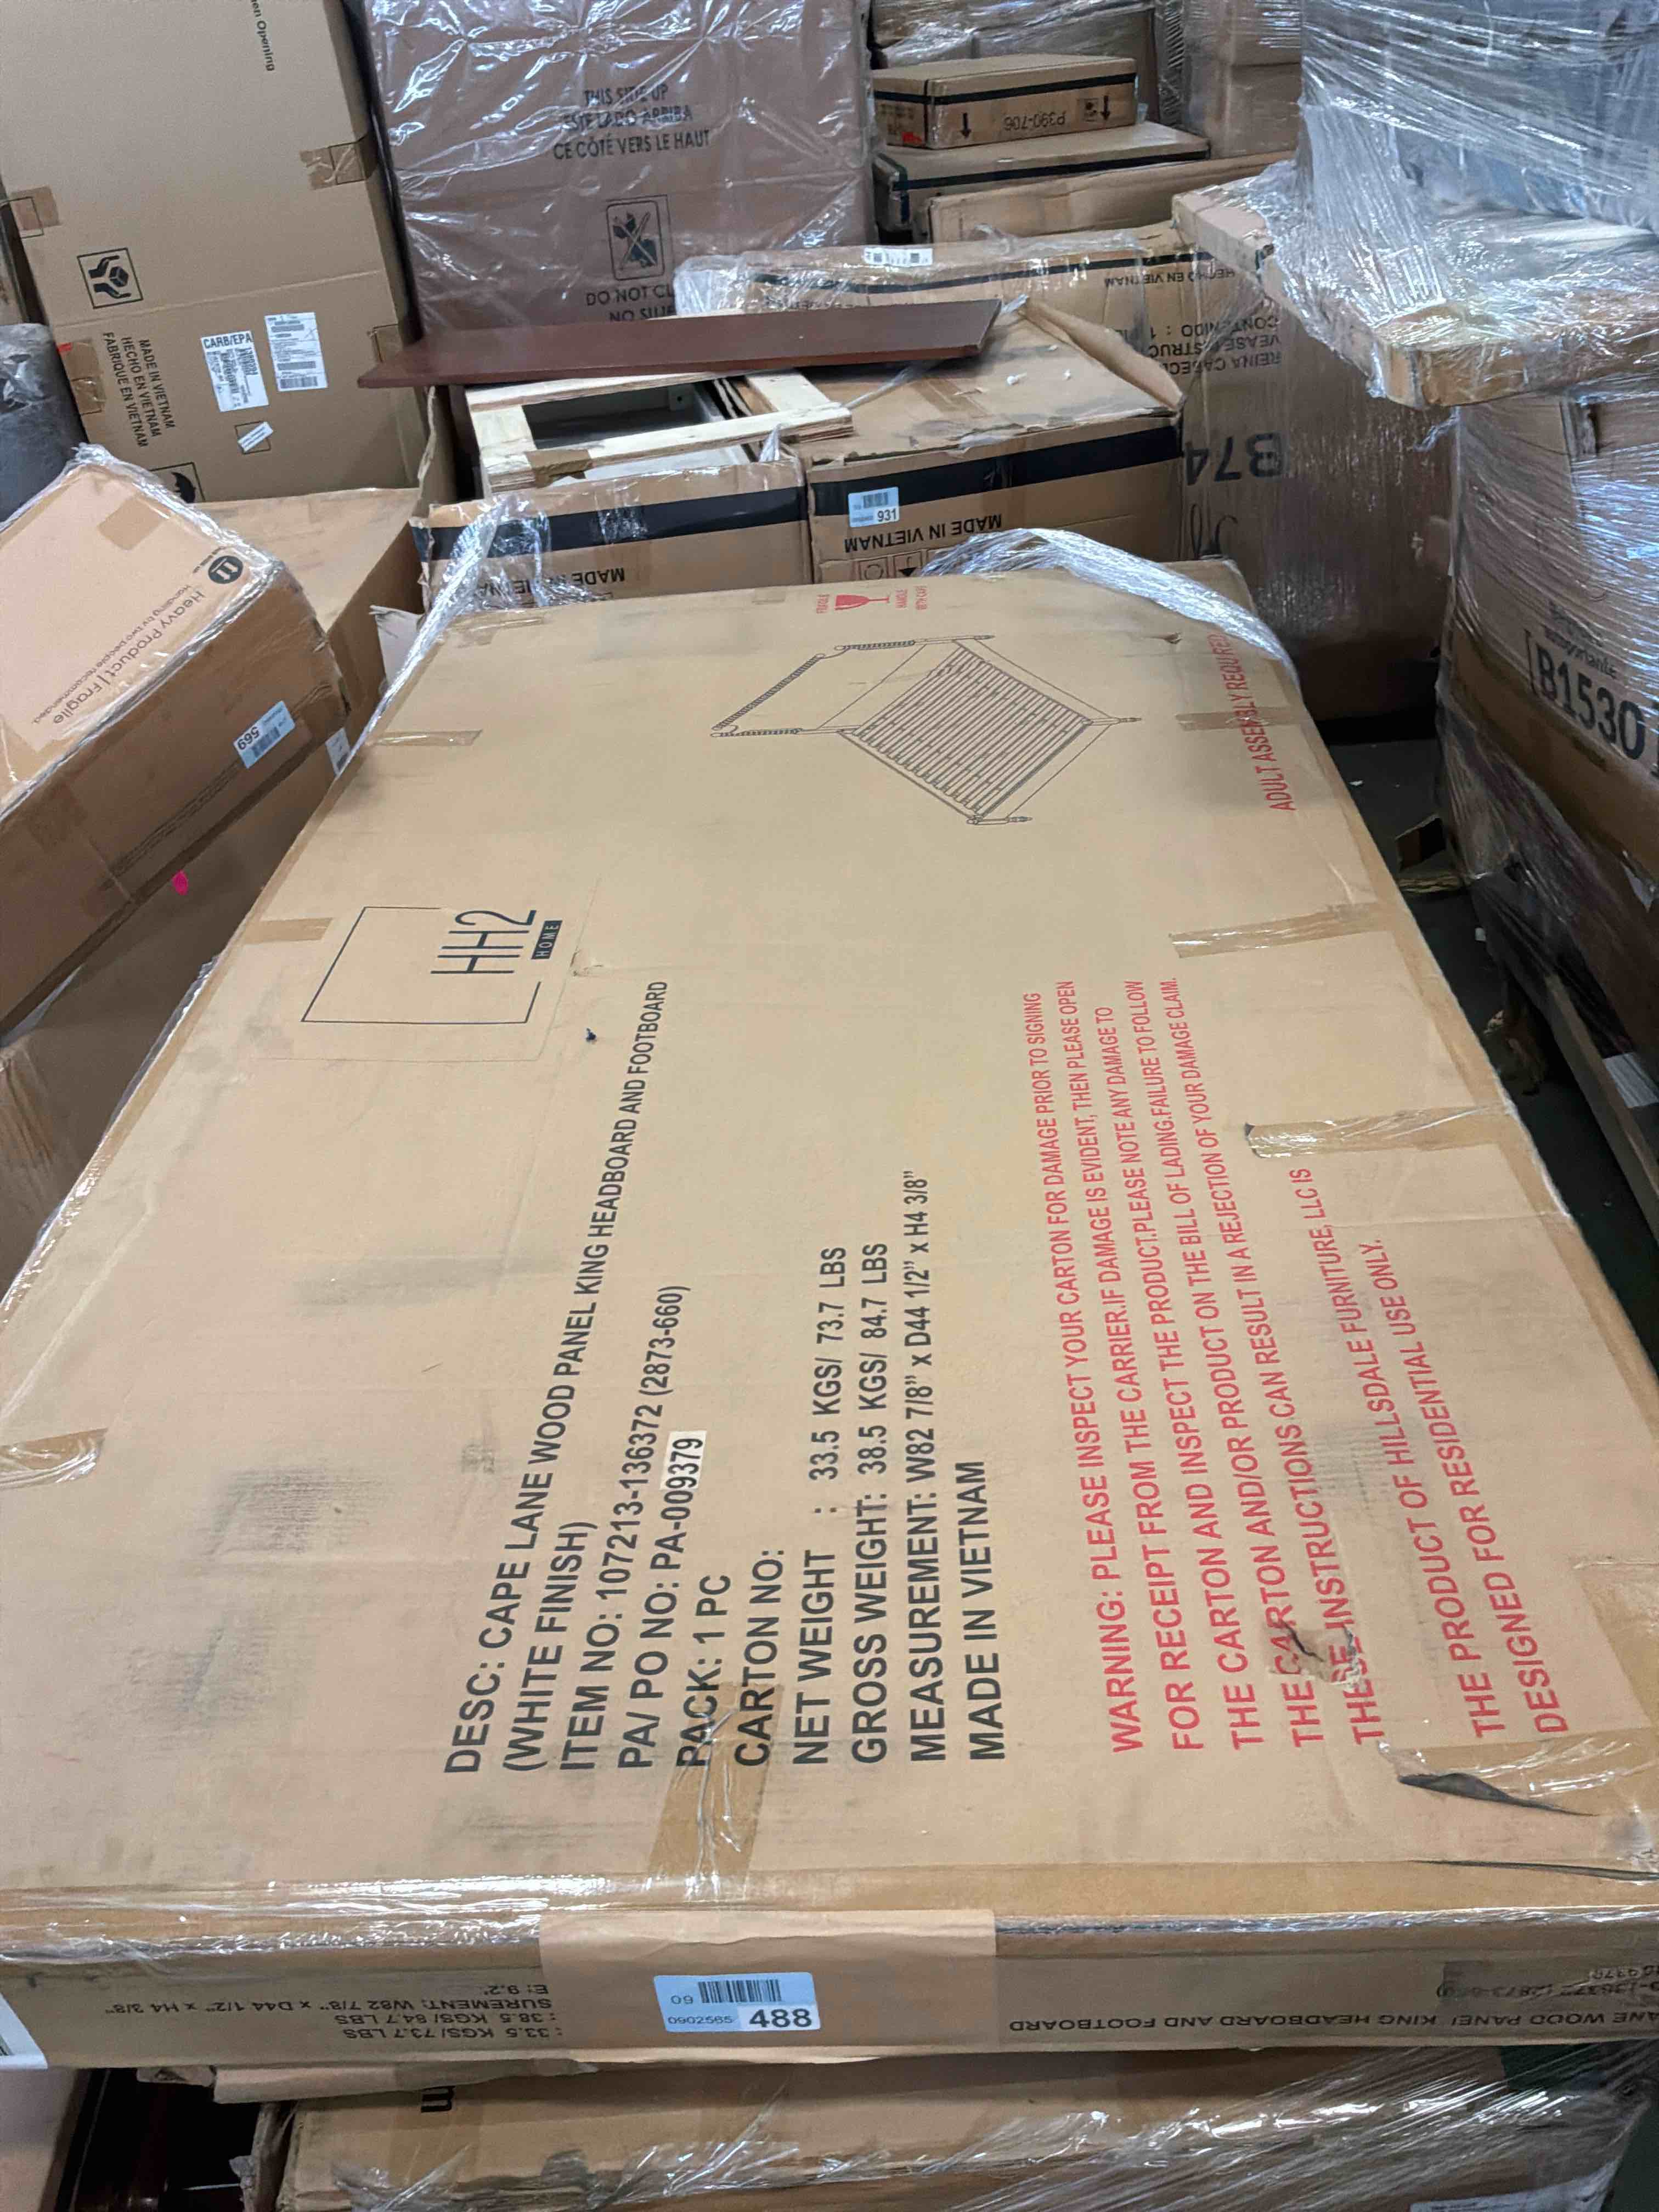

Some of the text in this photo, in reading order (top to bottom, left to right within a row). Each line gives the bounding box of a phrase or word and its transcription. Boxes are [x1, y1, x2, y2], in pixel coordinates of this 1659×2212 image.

[257, 21, 275, 71] Opening
[554, 142, 573, 159] CE
[617, 136, 652, 155] VERS
[656, 134, 670, 150] LE
[674, 129, 709, 149] HAUT
[586, 286, 652, 306] DO NOT
[1167, 272, 1184, 283] EN
[103, 332, 148, 448] FABRIQUE EN VIETNAM
[121, 336, 161, 437] HECHO EN VIETNAM
[139, 339, 175, 428] MADE IN VIETNAM
[1184, 433, 1282, 486] B74
[845, 514, 1001, 553] MADE IN VIETNAM
[878, 509, 896, 522] 931
[572, 568, 625, 585] MADE
[161, 590, 205, 628] Heavy
[106, 629, 161, 676] Product
[53, 683, 103, 724] Fragile
[1208, 634, 1297, 810] ADULT ASSEMBLY REQUIRED
[1537, 645, 1645, 759] B1530
[238, 726, 259, 750] 569
[431, 909, 537, 974] HH2
[536, 922, 559, 958] HOME
[1056, 981, 1077, 1014] OPEN
[1060, 1018, 1086, 1068] PLEASE
[1069, 1073, 1092, 1111] THEN
[1074, 1115, 1104, 1182] EVIDENT,
[1085, 1187, 1108, 1202] IS
[904, 1211, 928, 1236] H4
[1088, 1207, 1121, 1283] DAMAGE
[819, 1248, 846, 1288] LBS
[816, 1302, 844, 1344] 73.7
[904, 1306, 931, 1346] D44
[444, 981, 667, 1773] DESC: CAPE LANE WOOD PANEL KING HEADBOARD AND FOOTBOARD
[812, 1358, 842, 1415] KGS/
[1023, 993, 1143, 1753] WARNING: PLEASE INSPECT YOUR CARTON FOR DAMAGE PRIOR TO SIGNING
[809, 1431, 839, 1480] 33.5
[905, 1428, 935, 1483] W82
[1120, 1409, 1151, 1453] THE
[1289, 1169, 1505, 1738] THE PRODUCT OF HILLSDALE FURNITURE, LLC IS
[851, 1244, 887, 1763] GROSS WEIGHT: 38.5 KGS/ 84.7 LBS
[1128, 1461, 1166, 1534] FROM
[1358, 1240, 1569, 1735] DESIGNED FOR RESIDENTIAL USE ONLY.
[560, 1286, 691, 1770] ITEM NO: 107213-136372 (2873-660)
[618, 1438, 703, 1768] PA/ PO NO: PA-009379
[798, 1550, 835, 1681] WEIGHT
[906, 1493, 946, 1761] MEASUREMENT:
[955, 1462, 1005, 1759] MADE IN VIETNAM
[1142, 1544, 1190, 1670] RECEIPT
[503, 1522, 597, 1771] (WHITE FINISH)
[676, 1575, 730, 1767] PACK: 1 PC
[733, 1550, 783, 1766] CARTON NO:
[792, 1691, 830, 1764] NET
[1165, 1681, 1204, 1750] FOR
[668, 2008, 812, 2028] 0902565 488
[670, 1995, 694, 2004] 09
[1009, 2018, 1155, 2031] FOOTBOARD
[1164, 2016, 1213, 2027] AND
[1220, 2015, 1369, 2025] HEADBOARD
[1378, 2015, 1436, 2025] KING
[1530, 2013, 1604, 2024] WOOD
